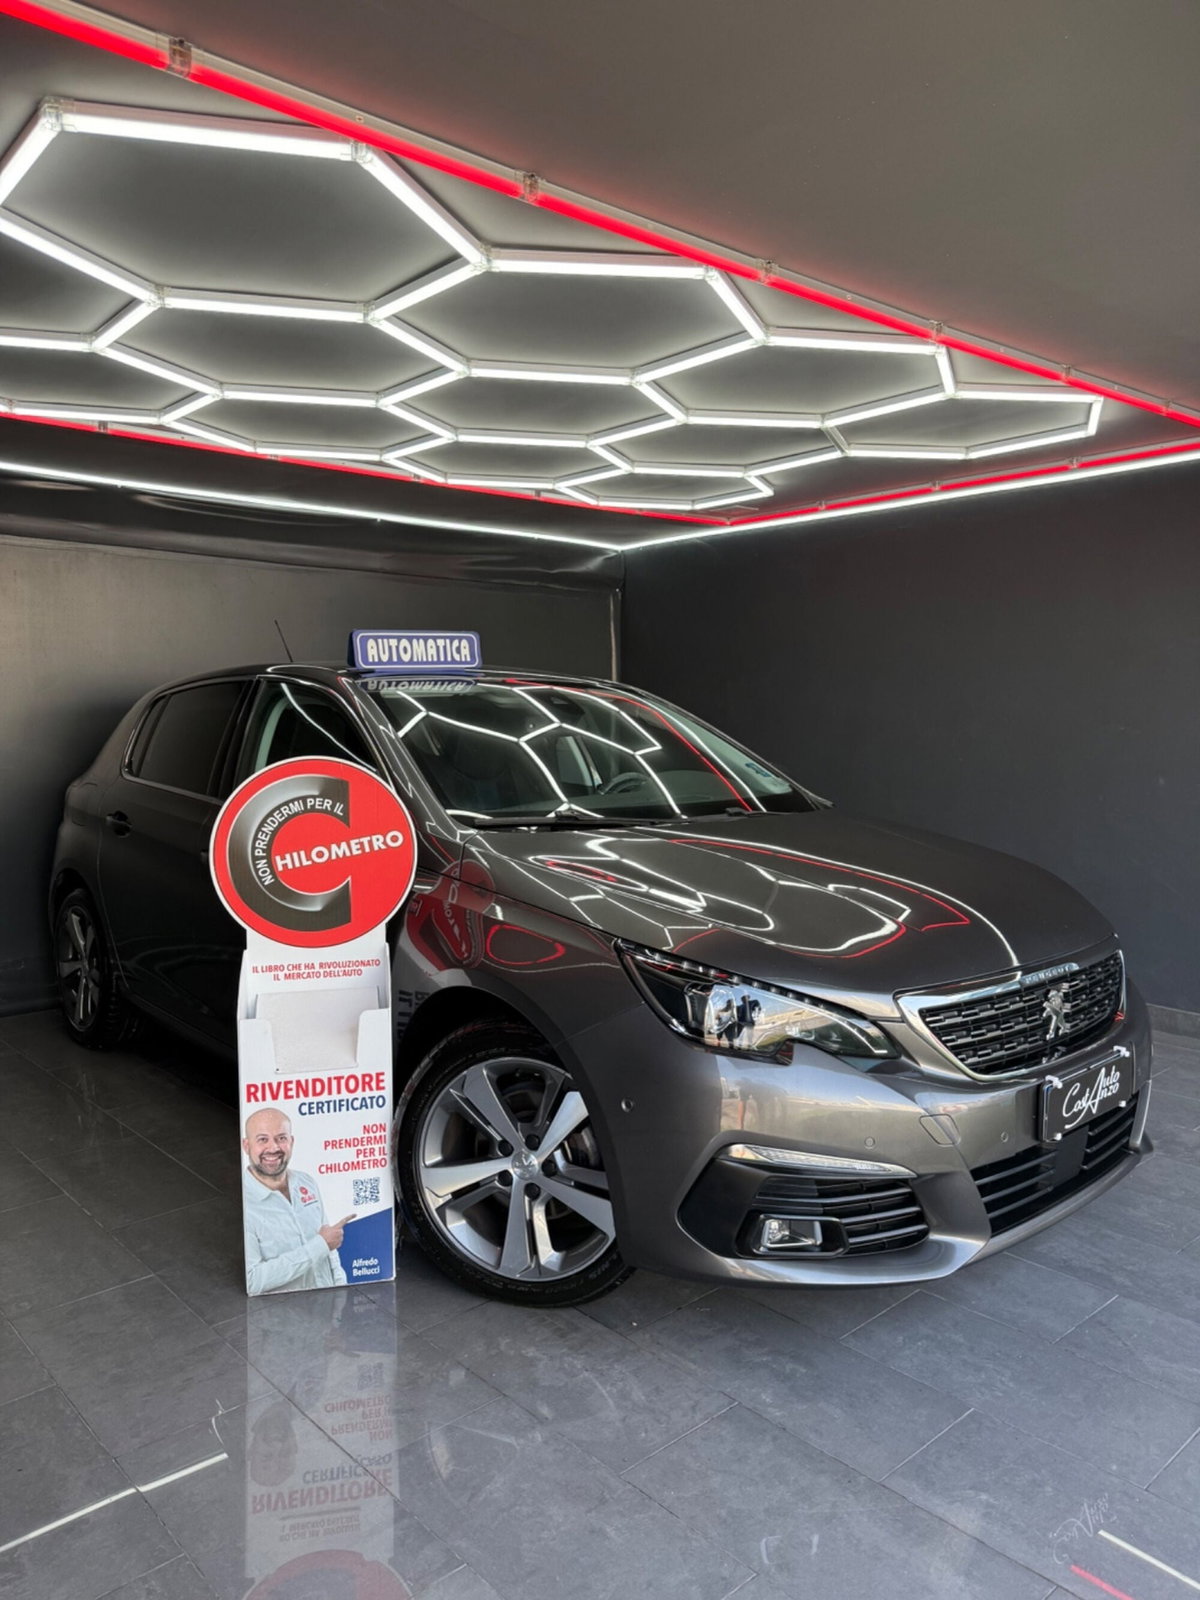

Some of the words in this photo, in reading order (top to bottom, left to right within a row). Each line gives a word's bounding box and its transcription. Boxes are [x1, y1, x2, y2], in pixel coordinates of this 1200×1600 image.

[366, 638, 471, 662] AUTOMATICA
[306, 797, 332, 811] PER
[334, 802, 345, 816] IL
[254, 800, 305, 857] PRENDERMI
[254, 858, 275, 886] NON
[252, 966, 259, 974] IL
[260, 964, 285, 973] LIBRO
[286, 963, 303, 972] CHE
[304, 962, 316, 970] HA
[318, 959, 381, 970] RIVOLUZIONATO
[273, 973, 281, 981] IL
[283, 971, 321, 981] MERCATO
[322, 968, 363, 978] DELL'AUTO
[245, 1072, 386, 1103] RIVENDITORE
[298, 1095, 386, 1116] CERTIFICATO
[362, 1123, 387, 1135] NON
[323, 1135, 387, 1150] PRENDERMI
[355, 1148, 376, 1159] PER
[378, 1146, 388, 1157] IL
[318, 1158, 388, 1174] CHILOMETRO
[352, 1257, 379, 1268] Alfredo
[352, 1267, 381, 1277] Bellucci
